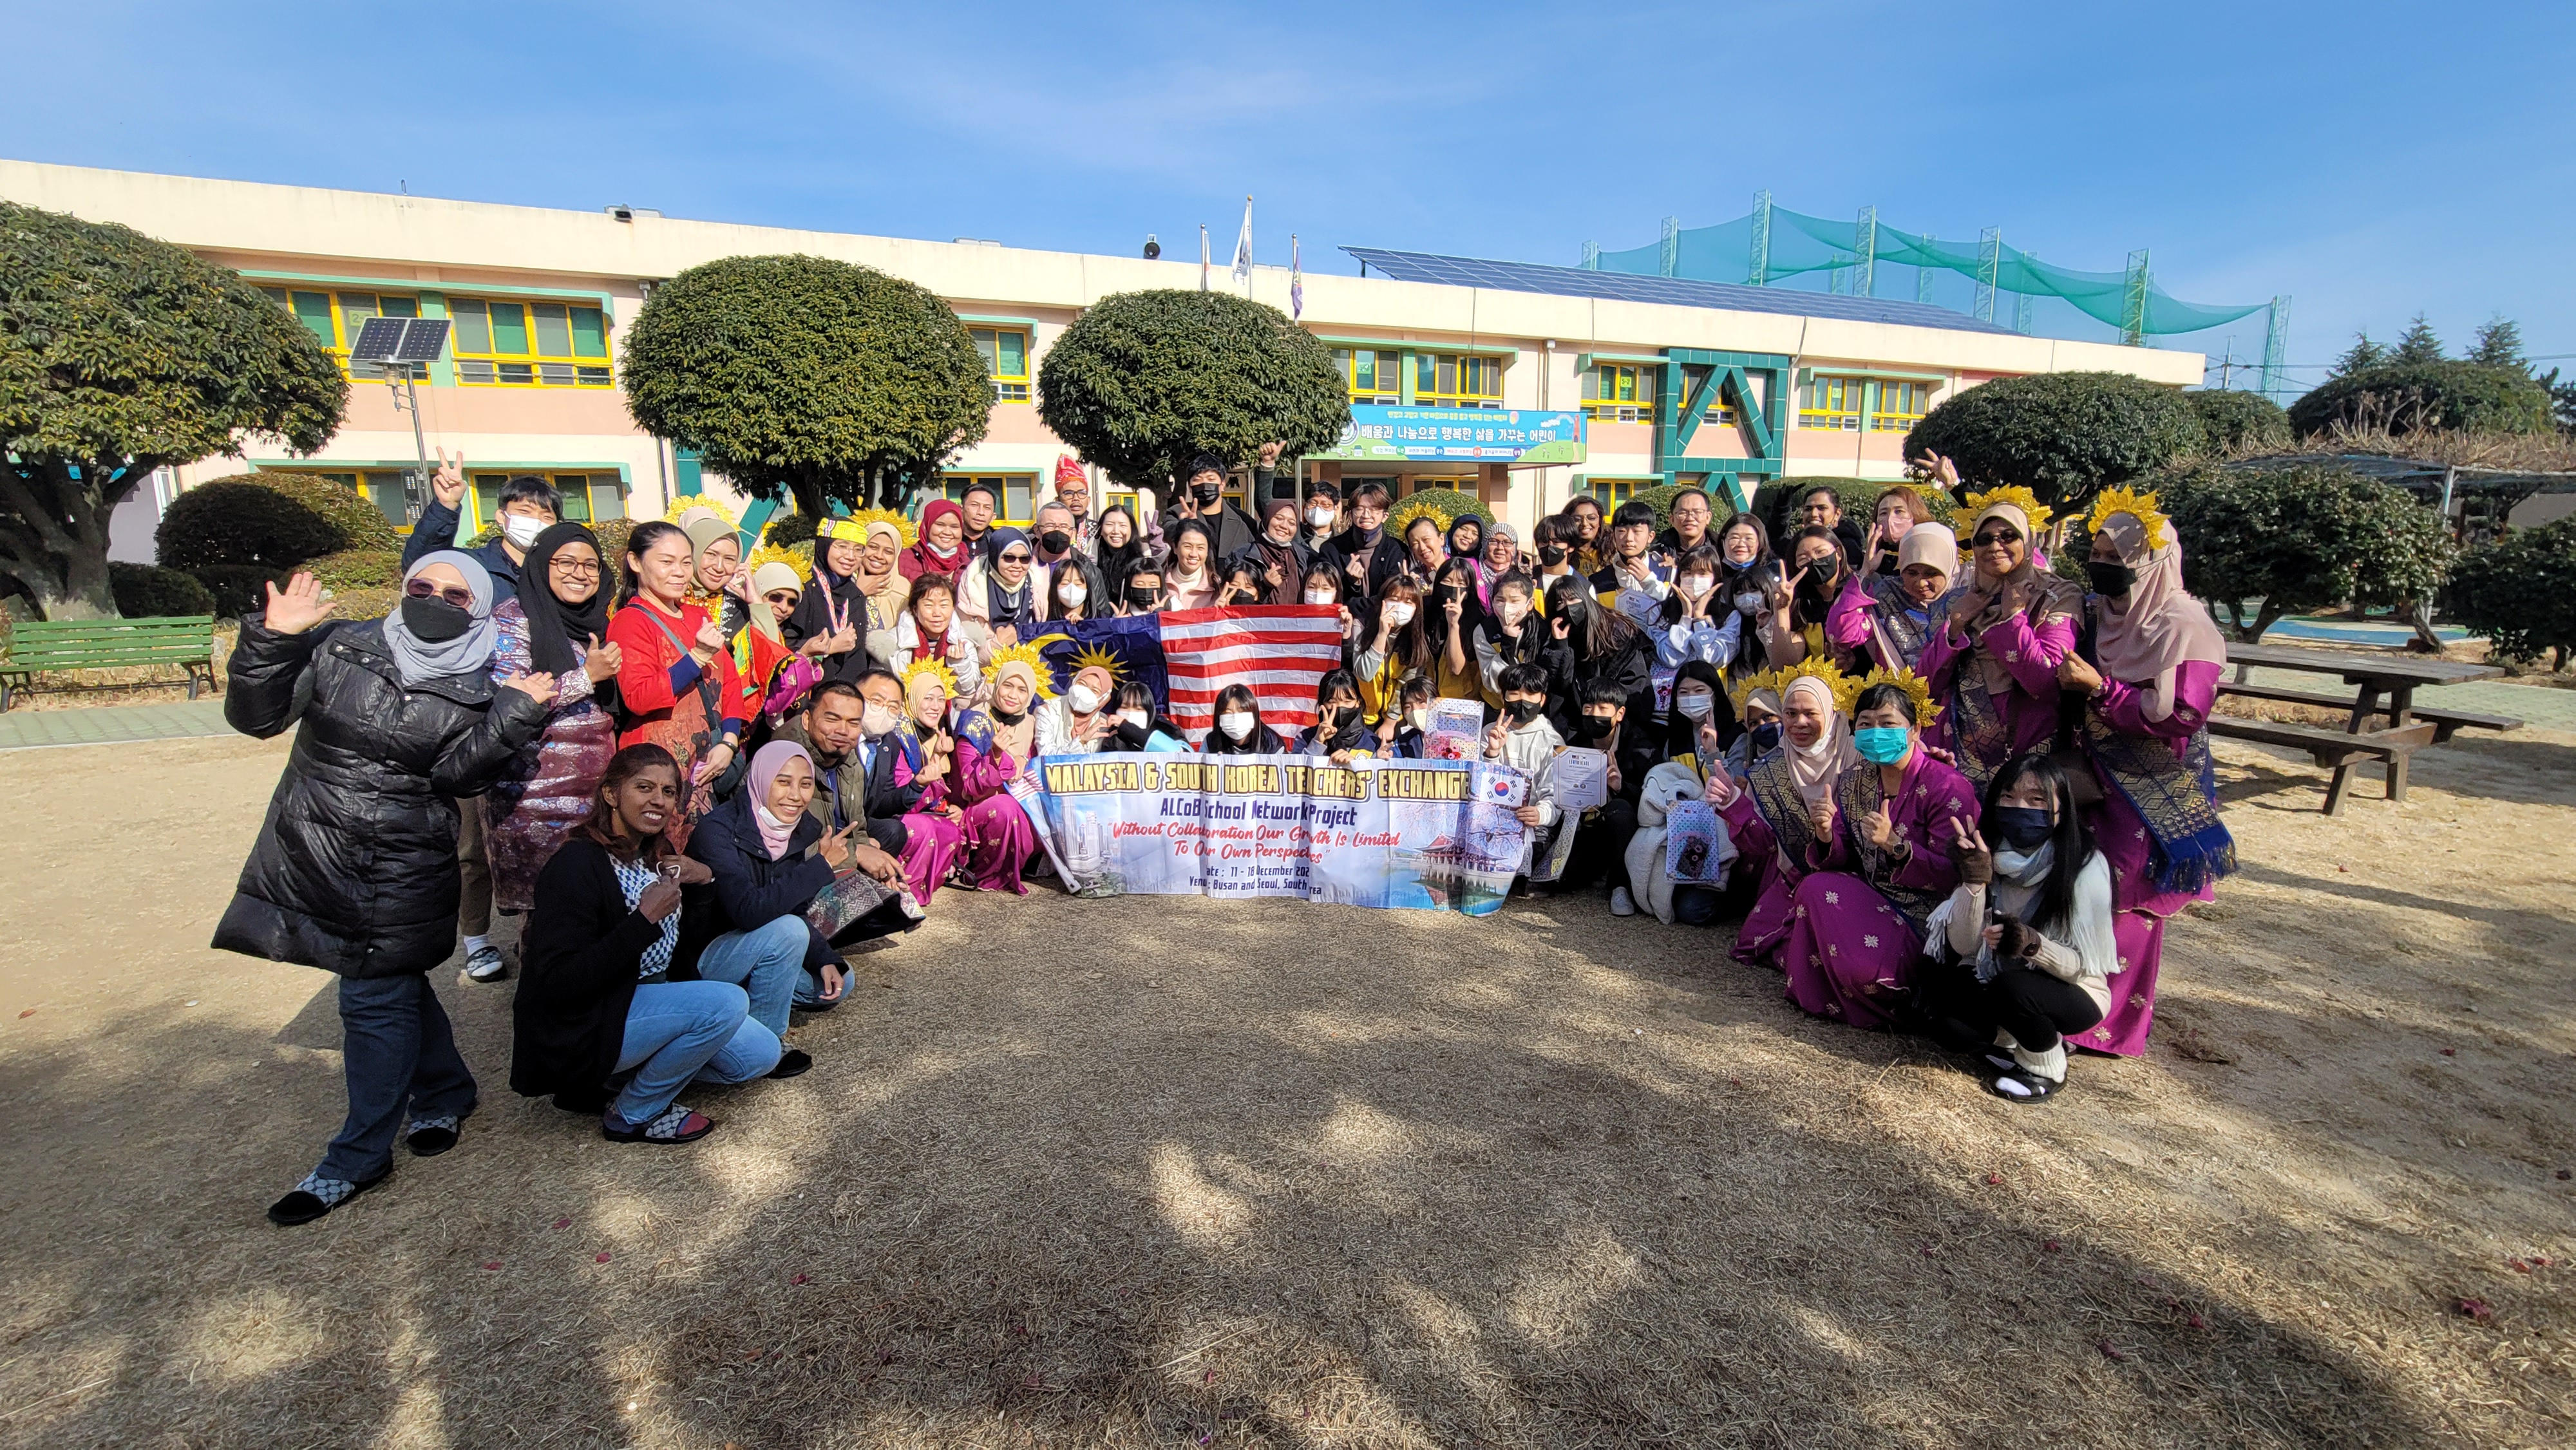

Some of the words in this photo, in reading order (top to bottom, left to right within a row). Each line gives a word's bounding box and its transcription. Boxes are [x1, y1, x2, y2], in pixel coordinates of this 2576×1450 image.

[1361, 425, 1394, 439] 배움과
[1397, 425, 1438, 440] 나눔으로
[1441, 426, 1472, 441] 행복한
[1475, 428, 1494, 442] 삶을
[1498, 428, 1526, 442] 가꾸는
[1530, 429, 1557, 443] 어린이
[1045, 762, 1139, 794] MALAYSIA
[1144, 762, 1160, 790] &
[1165, 762, 1219, 793] SOUTH
[1224, 764, 1281, 793] KOREA
[1285, 765, 1372, 800] TEACHERS'
[1376, 769, 1470, 801] EXCHANGE
[1160, 798, 1201, 816] ALCoB
[1204, 800, 1247, 820] School
[1251, 800, 1309, 821] Network
[1309, 804, 1358, 829] Project
[1256, 824, 1284, 841] Our
[1335, 831, 1347, 847] Is
[1352, 831, 1401, 847] Limited
[1174, 840, 1189, 856] To
[1221, 843, 1253, 860] Own
[1206, 866, 1219, 876] ate
[1231, 867, 1238, 877] 11
[1247, 866, 1255, 877] 18
[1256, 865, 1293, 876] December
[1213, 880, 1238, 890] Busan
[1241, 878, 1255, 890] and
[1257, 878, 1280, 890] Seoul,
[1283, 878, 1307, 890] South
